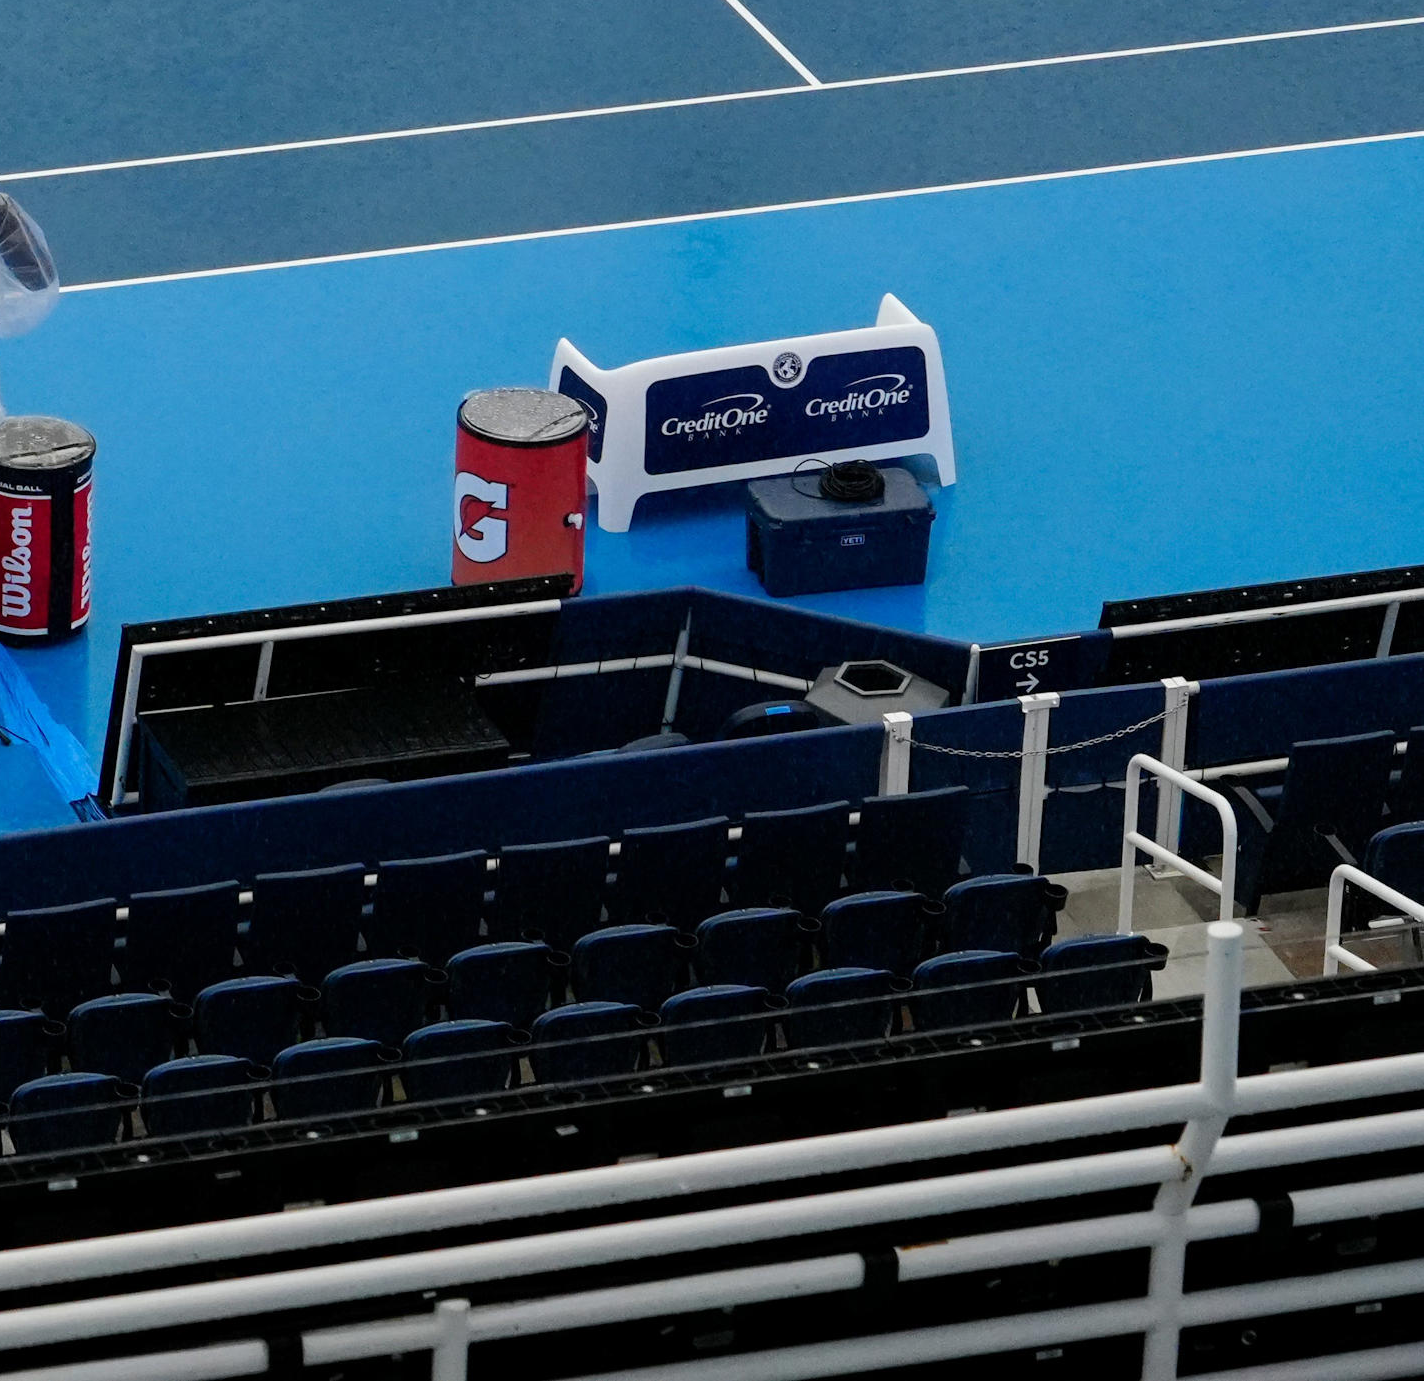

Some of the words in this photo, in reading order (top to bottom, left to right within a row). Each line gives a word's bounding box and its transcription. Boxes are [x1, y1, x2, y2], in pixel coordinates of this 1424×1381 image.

[805, 388, 910, 417] CreditOne
[661, 408, 769, 436] CreditOne
[831, 408, 885, 422] BANK
[688, 428, 742, 442] BANK
[16, 484, 43, 492] BALL
[1, 506, 33, 618] Wilson
[1009, 649, 1049, 669] CS5
